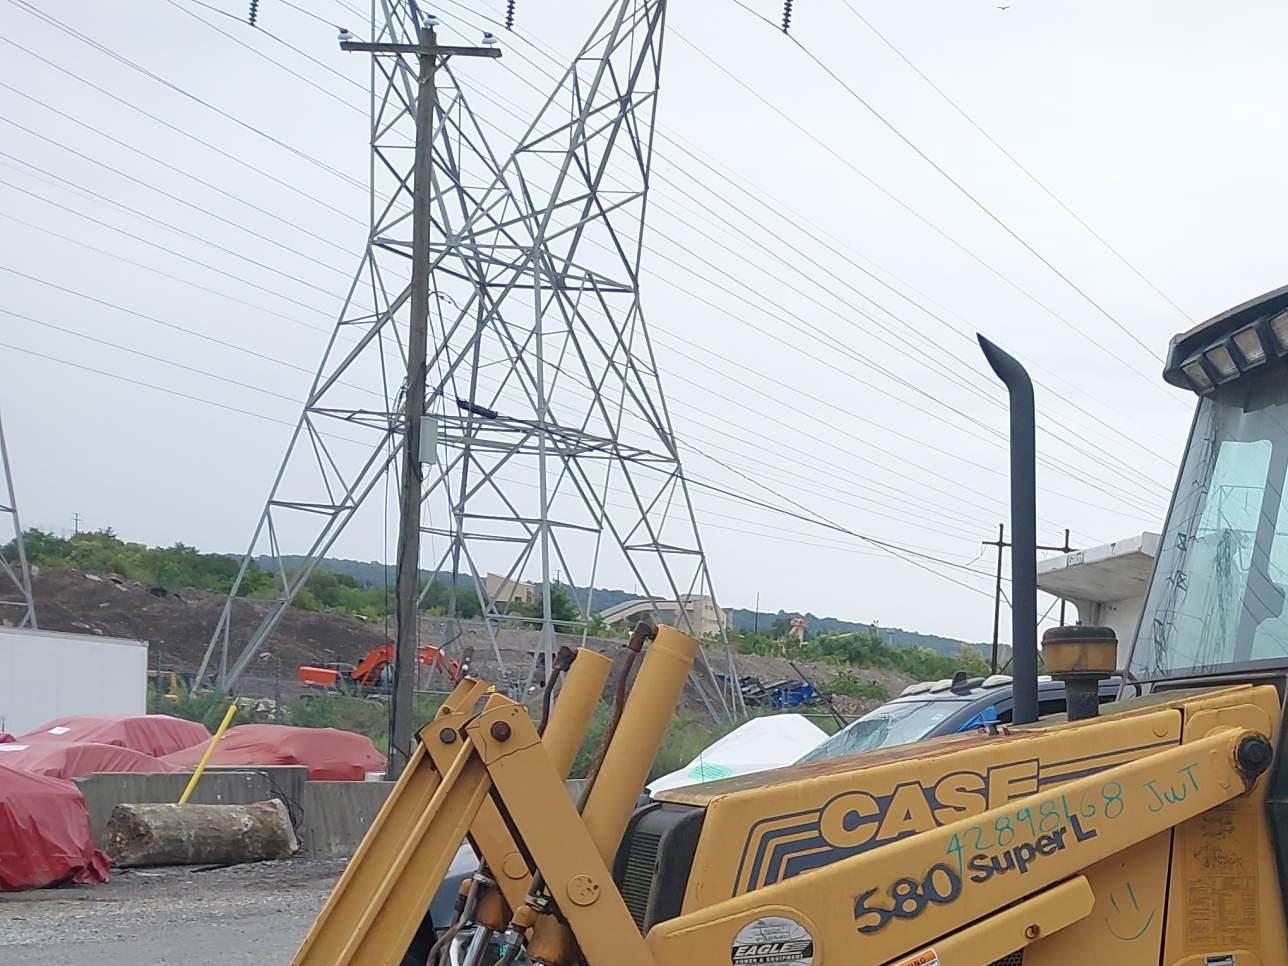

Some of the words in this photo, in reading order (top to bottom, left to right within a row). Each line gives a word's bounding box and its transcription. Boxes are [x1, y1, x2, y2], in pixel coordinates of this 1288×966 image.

[819, 758, 1040, 849] CASE
[945, 781, 1125, 876] 42898168
[854, 862, 963, 934] 580
[967, 825, 1067, 883] Super
[1070, 814, 1098, 844] L
[734, 942, 793, 957] EAGLE
